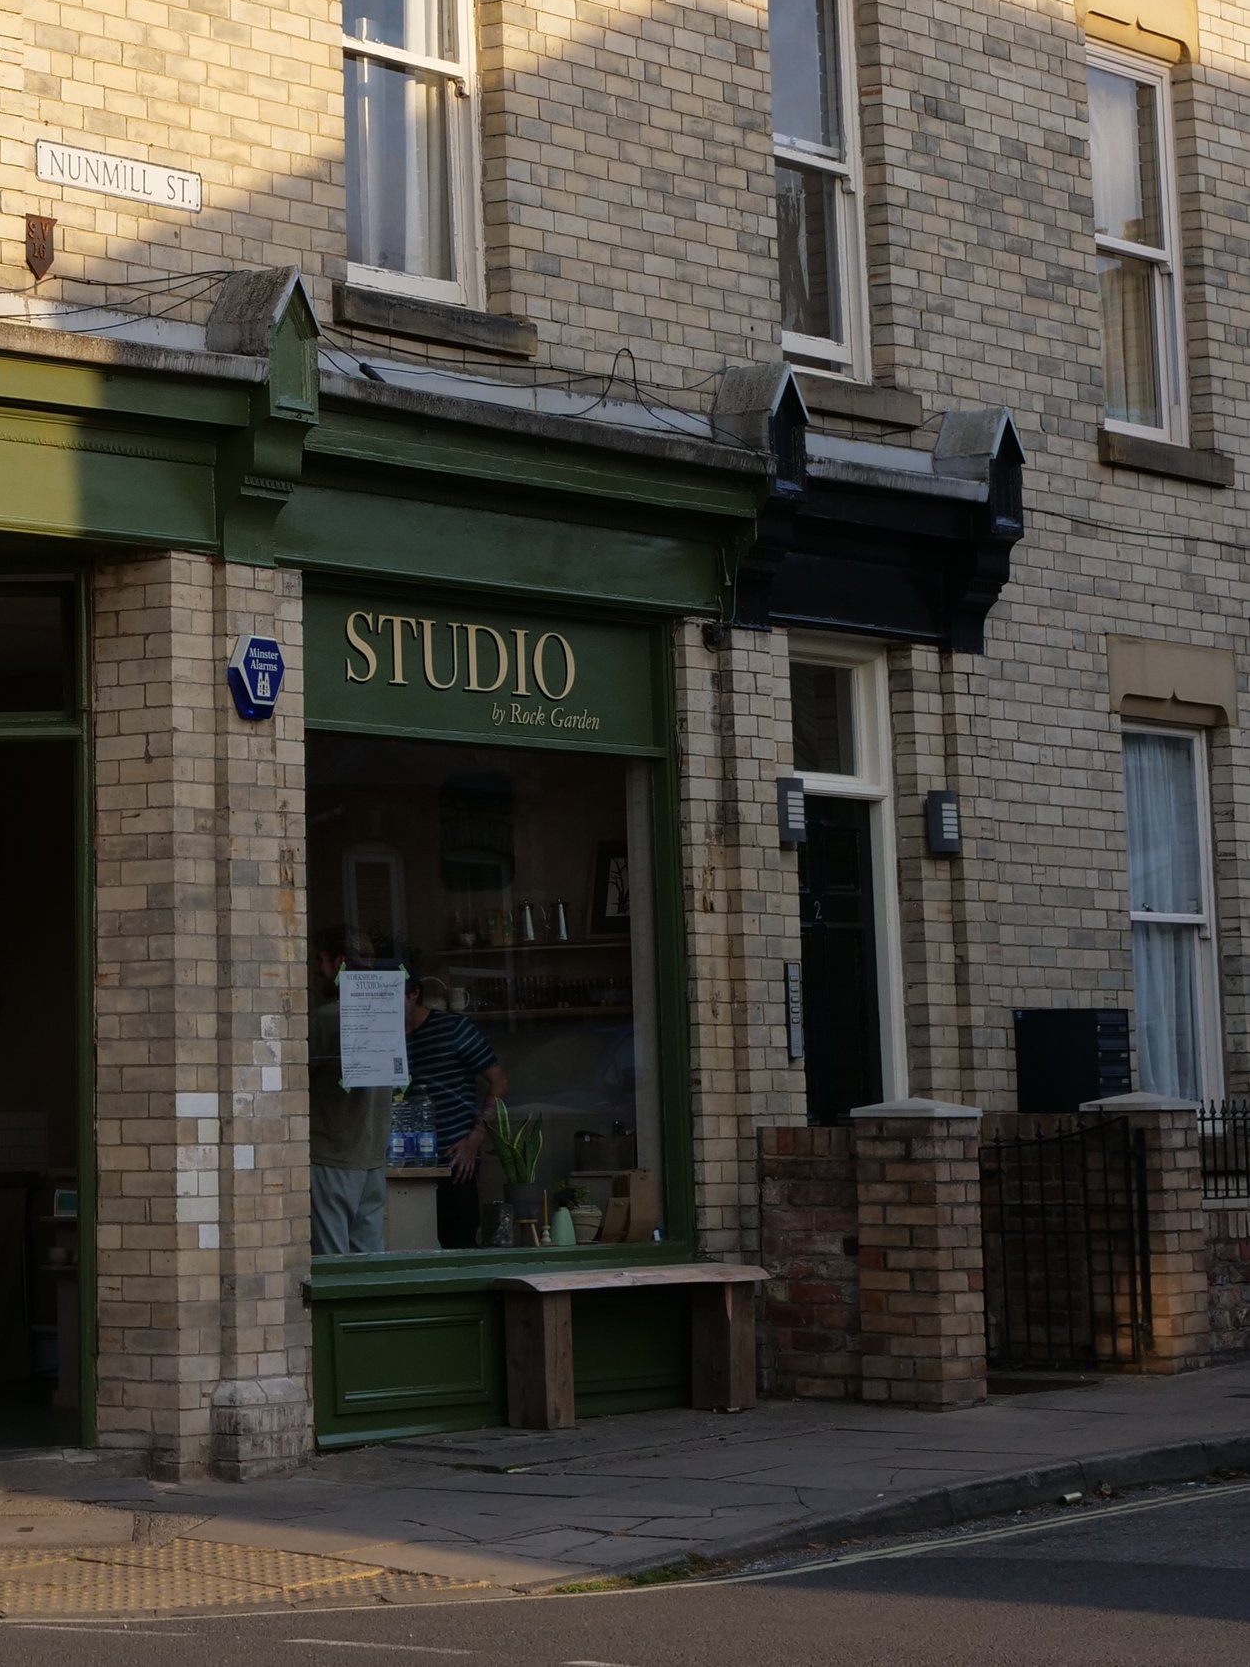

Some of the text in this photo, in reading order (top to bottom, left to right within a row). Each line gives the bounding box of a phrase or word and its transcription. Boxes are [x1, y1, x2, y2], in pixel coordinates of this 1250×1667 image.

[49, 149, 192, 204] NUNMILL ST.
[249, 647, 279, 660] Minster
[250, 658, 278, 672] Alarms
[346, 610, 576, 700] STUDIO
[491, 703, 600, 731] by Rock Garden
[813, 900, 822, 919] 2
